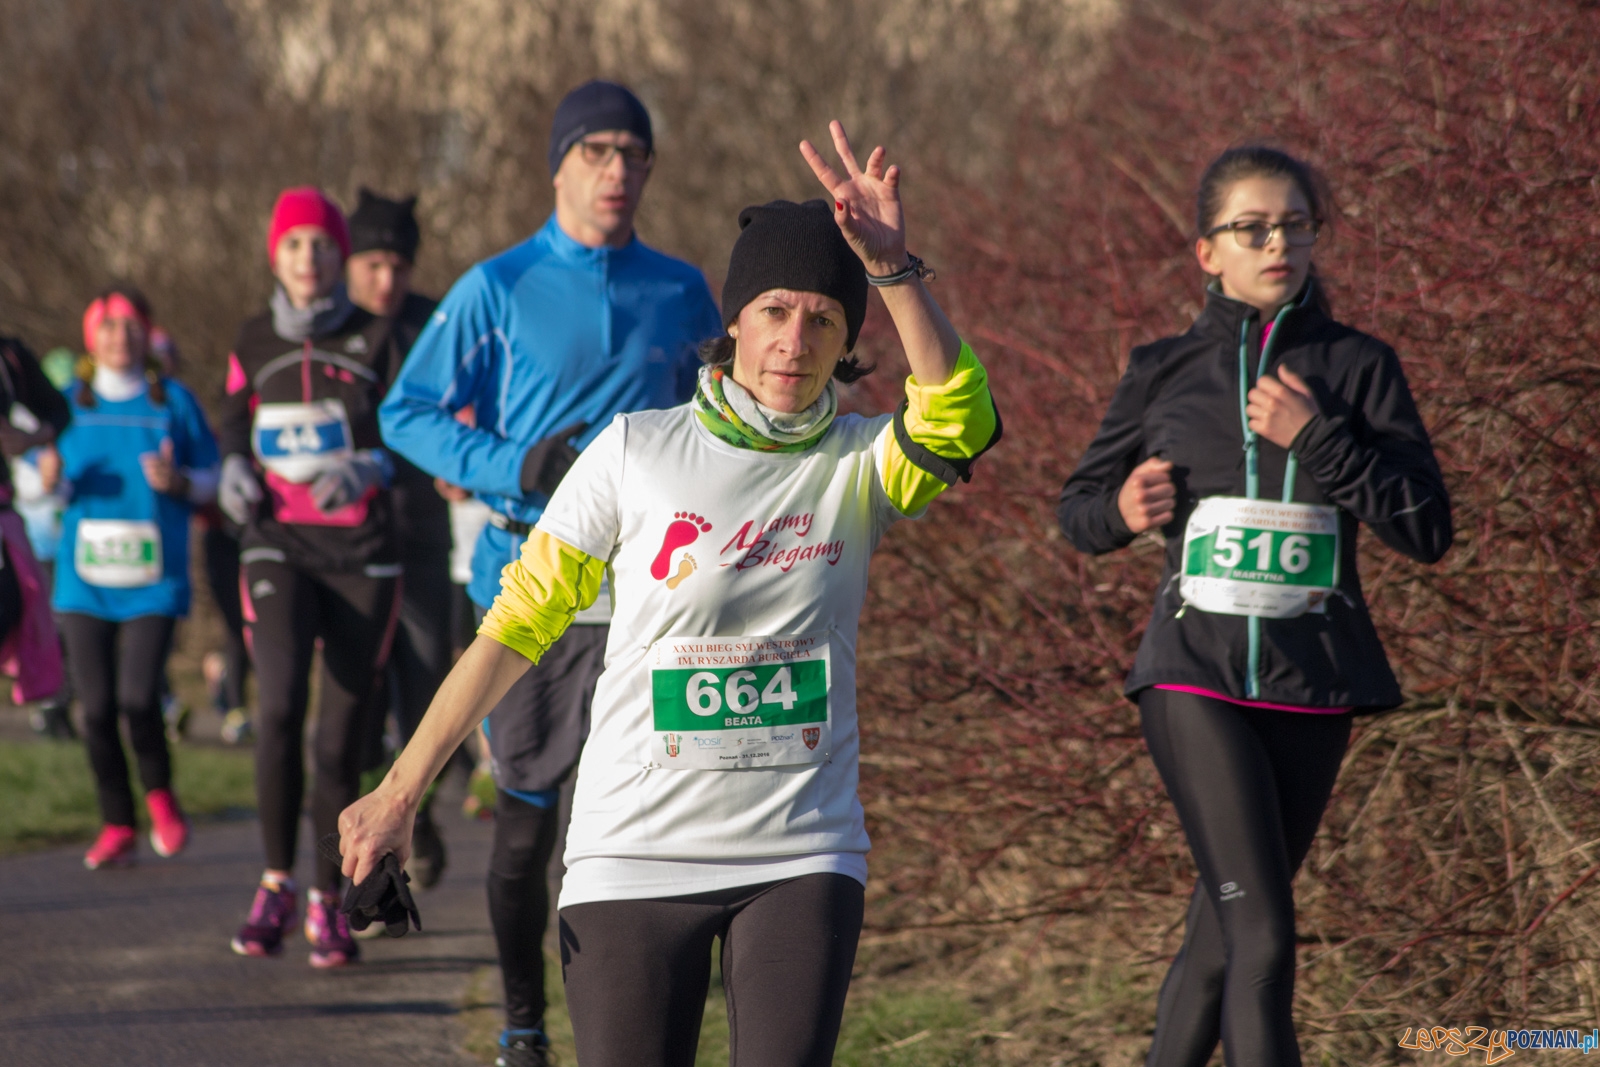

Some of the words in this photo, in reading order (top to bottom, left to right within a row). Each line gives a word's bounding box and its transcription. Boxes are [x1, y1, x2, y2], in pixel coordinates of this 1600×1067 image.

[719, 540, 844, 573] Biegamy
[1212, 526, 1311, 574] 516
[1232, 570, 1286, 582] MARTYNA
[673, 644, 703, 653] XXXII
[706, 642, 733, 652] BIEG
[735, 637, 816, 652] SYLWESTROWY
[678, 656, 695, 666] IM.
[699, 654, 756, 665] RYSZARDA
[686, 667, 798, 717] 664
[724, 716, 763, 726] BEATA
